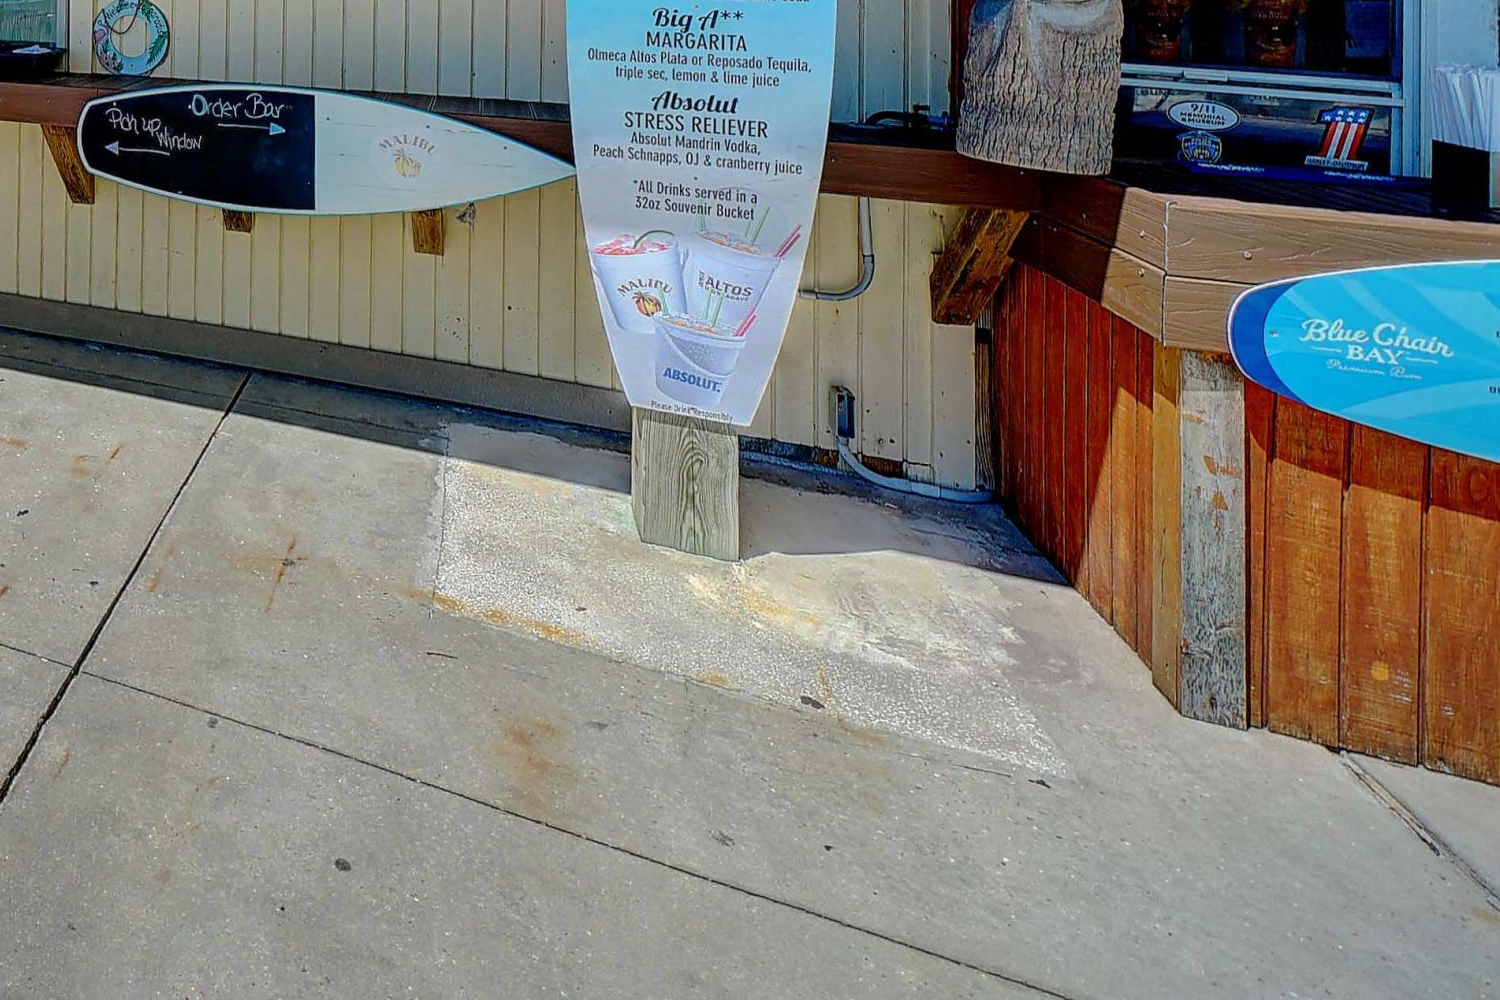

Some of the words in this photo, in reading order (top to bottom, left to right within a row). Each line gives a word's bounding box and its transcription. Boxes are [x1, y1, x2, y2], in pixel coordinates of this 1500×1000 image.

[652, 7, 694, 33] Big
[646, 31, 747, 51] MARGARITA
[191, 94, 242, 118] Order
[244, 93, 285, 119] Bar
[651, 91, 739, 114] Absolut
[1190, 103, 1216, 114] 9/11
[624, 111, 685, 132] STRESS
[691, 116, 768, 138] RELIEVER
[1179, 111, 1227, 122] MEMORIAL
[156, 126, 202, 151] Window
[657, 180, 691, 198] Drinks
[694, 184, 732, 201] served
[736, 189, 746, 203] in
[750, 194, 757, 205] a
[635, 196, 661, 211] 32oz
[664, 198, 713, 217] Souvenir
[716, 203, 754, 221] Bucket
[704, 275, 754, 298] ALTOS
[1300, 318, 1370, 343] Blue
[1373, 322, 1455, 358] Chair
[1346, 344, 1404, 366] BAY
[650, 400, 672, 411] Please
